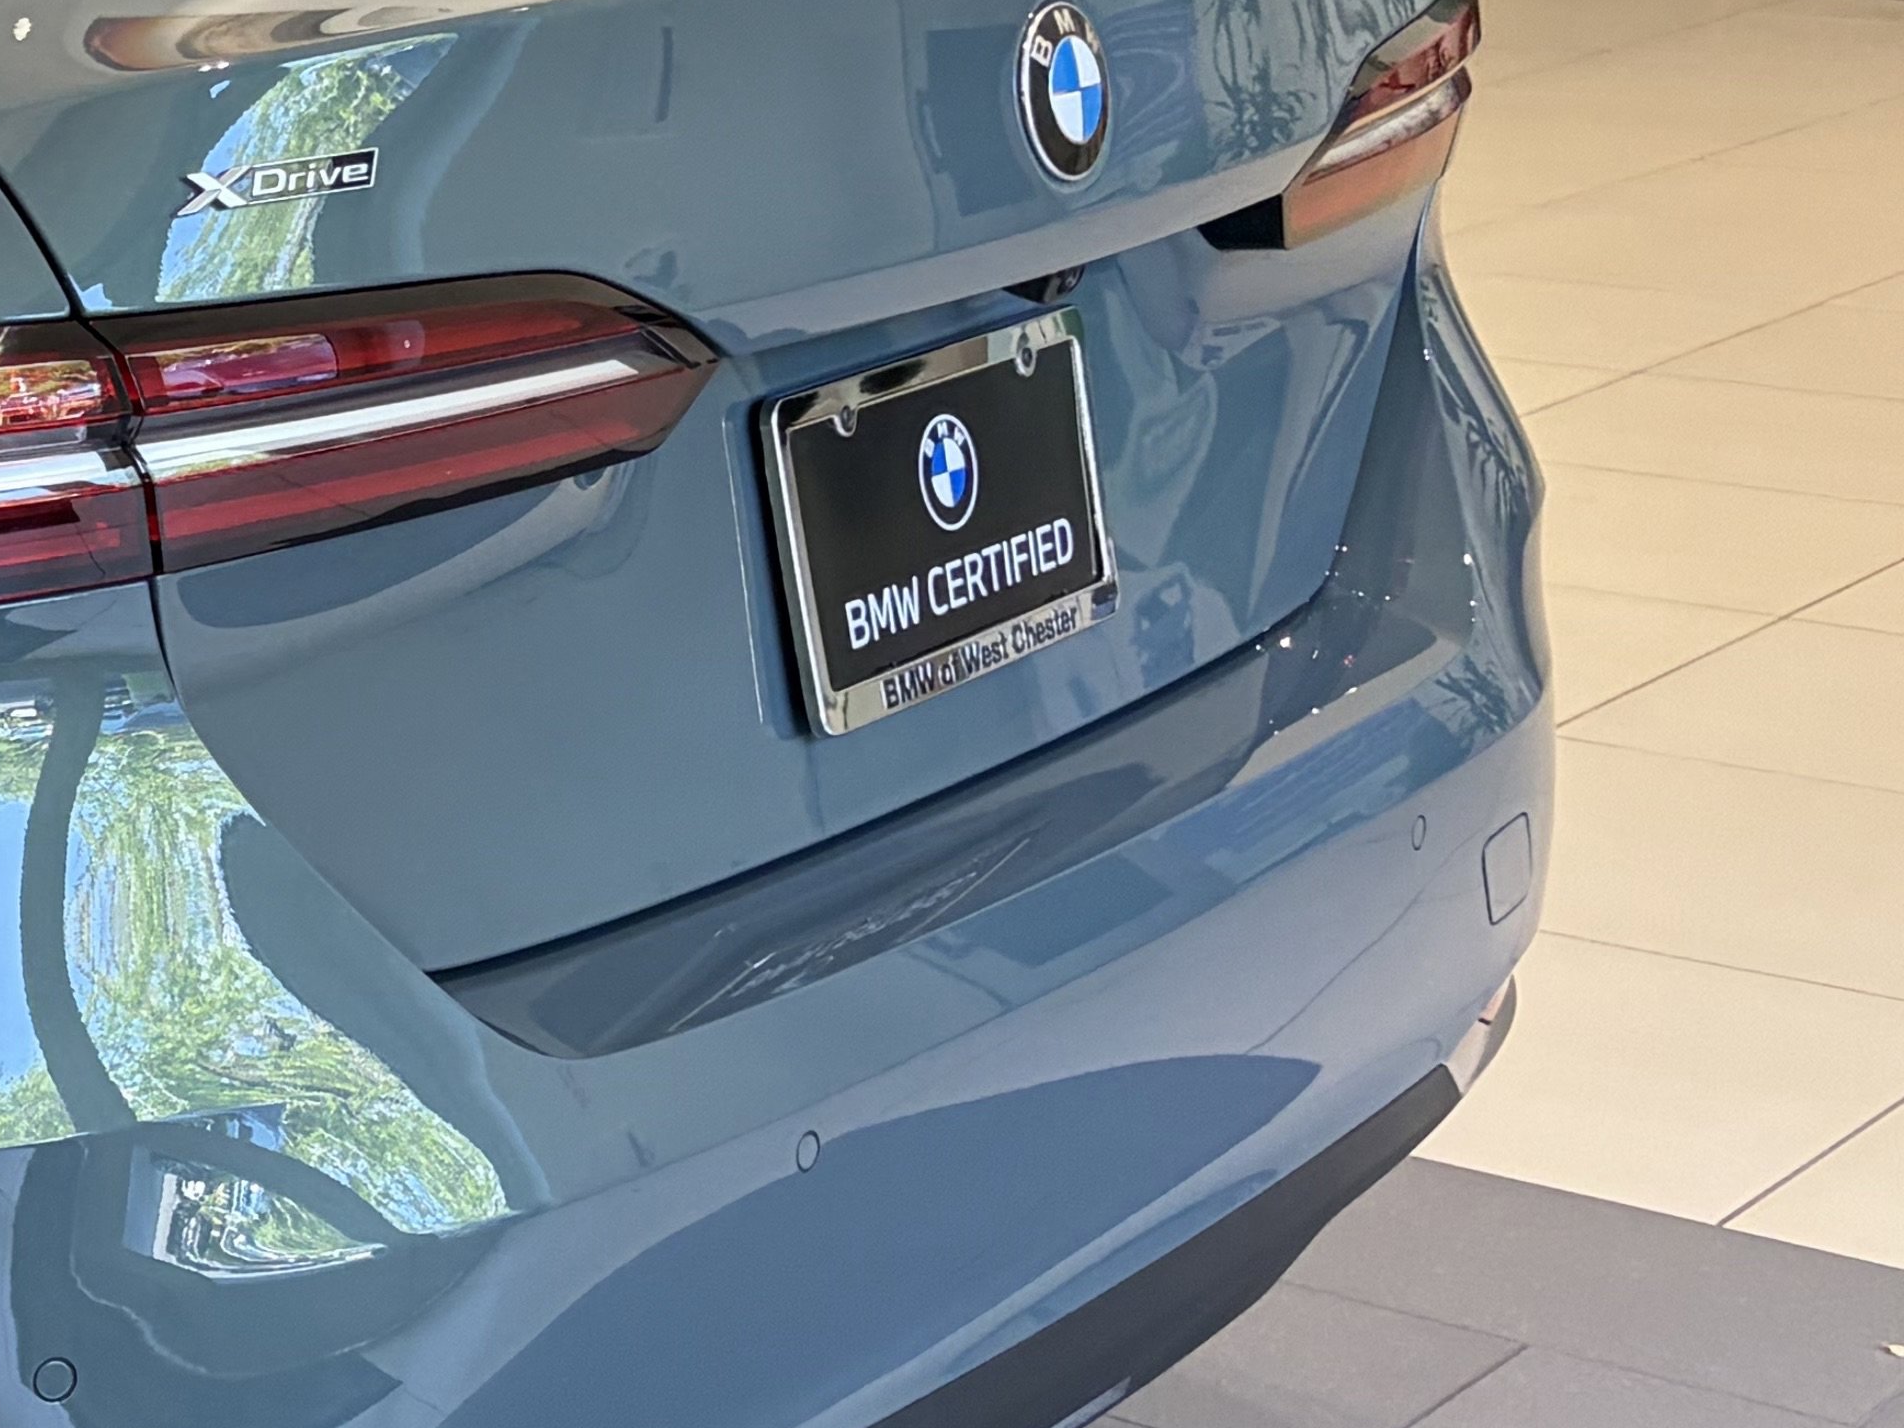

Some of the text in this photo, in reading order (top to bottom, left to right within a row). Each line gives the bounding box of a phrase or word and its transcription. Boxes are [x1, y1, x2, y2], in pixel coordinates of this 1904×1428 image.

[845, 517, 1074, 650] BMW CERTIFIED
[882, 606, 1078, 709] BMW of West Chester
